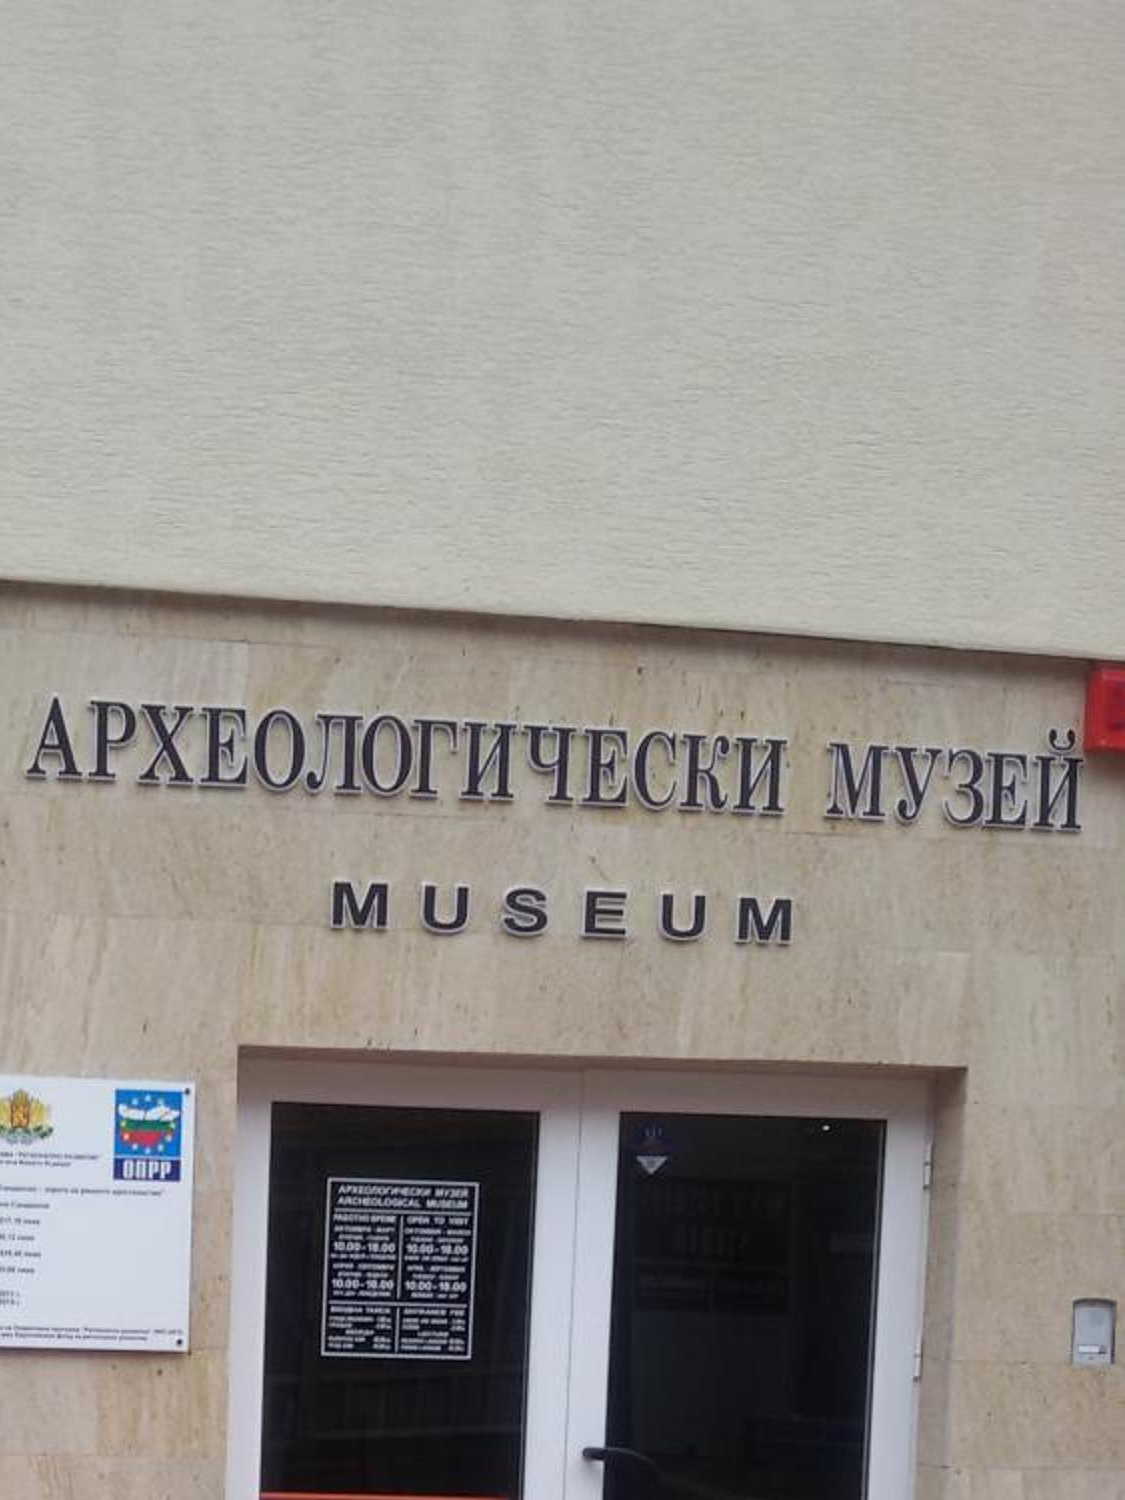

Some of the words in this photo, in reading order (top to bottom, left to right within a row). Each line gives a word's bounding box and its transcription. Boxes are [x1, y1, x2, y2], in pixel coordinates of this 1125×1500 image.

[26, 694, 788, 815] АРХЕОЛОГИЧЕСКИ
[825, 728, 1084, 832] МУЗЕЙ
[330, 878, 794, 945] MUSEUM
